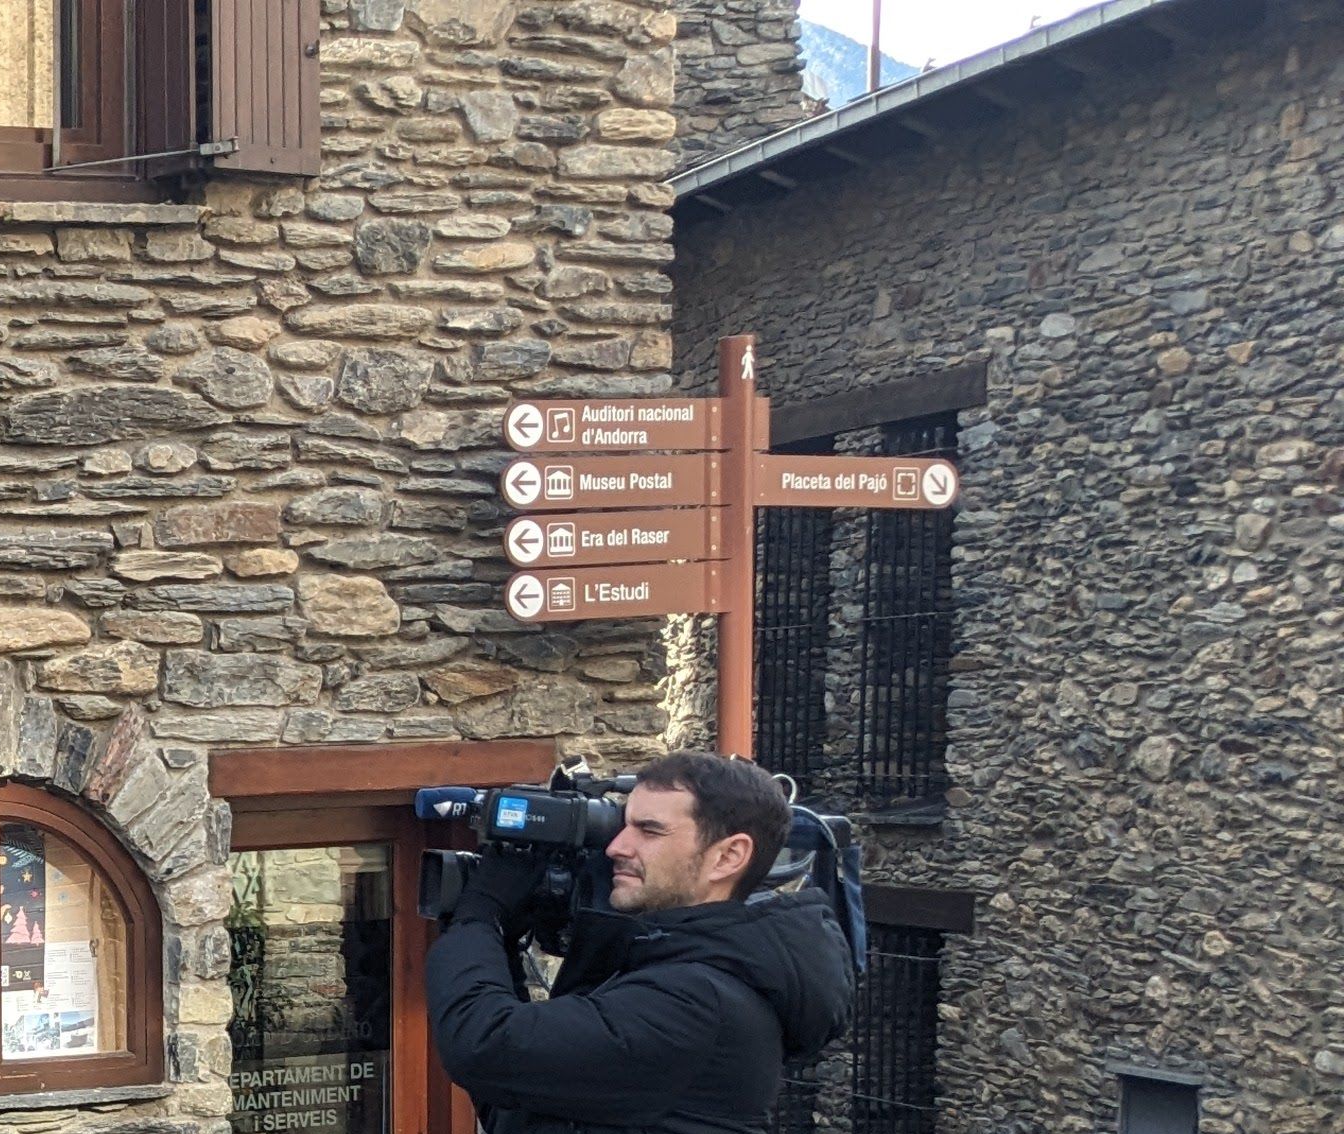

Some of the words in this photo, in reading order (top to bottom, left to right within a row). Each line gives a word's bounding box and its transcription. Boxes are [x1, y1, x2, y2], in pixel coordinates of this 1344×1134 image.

[581, 405, 634, 422] Auditori
[638, 404, 694, 421] nacional
[581, 428, 648, 445] d'Andorra
[579, 474, 626, 490] Museu
[629, 472, 673, 489] Postal
[781, 472, 831, 490] Placeta
[834, 473, 855, 490] del
[858, 473, 888, 494] Pajó
[581, 530, 604, 547] Era
[607, 529, 628, 546] del
[631, 528, 670, 545] Raser
[584, 581, 650, 602] L'Estudi
[229, 1063, 346, 1090] EPARTAMENT
[350, 1061, 374, 1080] DE
[232, 1085, 361, 1111] MANTENIMENT
[263, 1109, 337, 1131] SERVEIS
